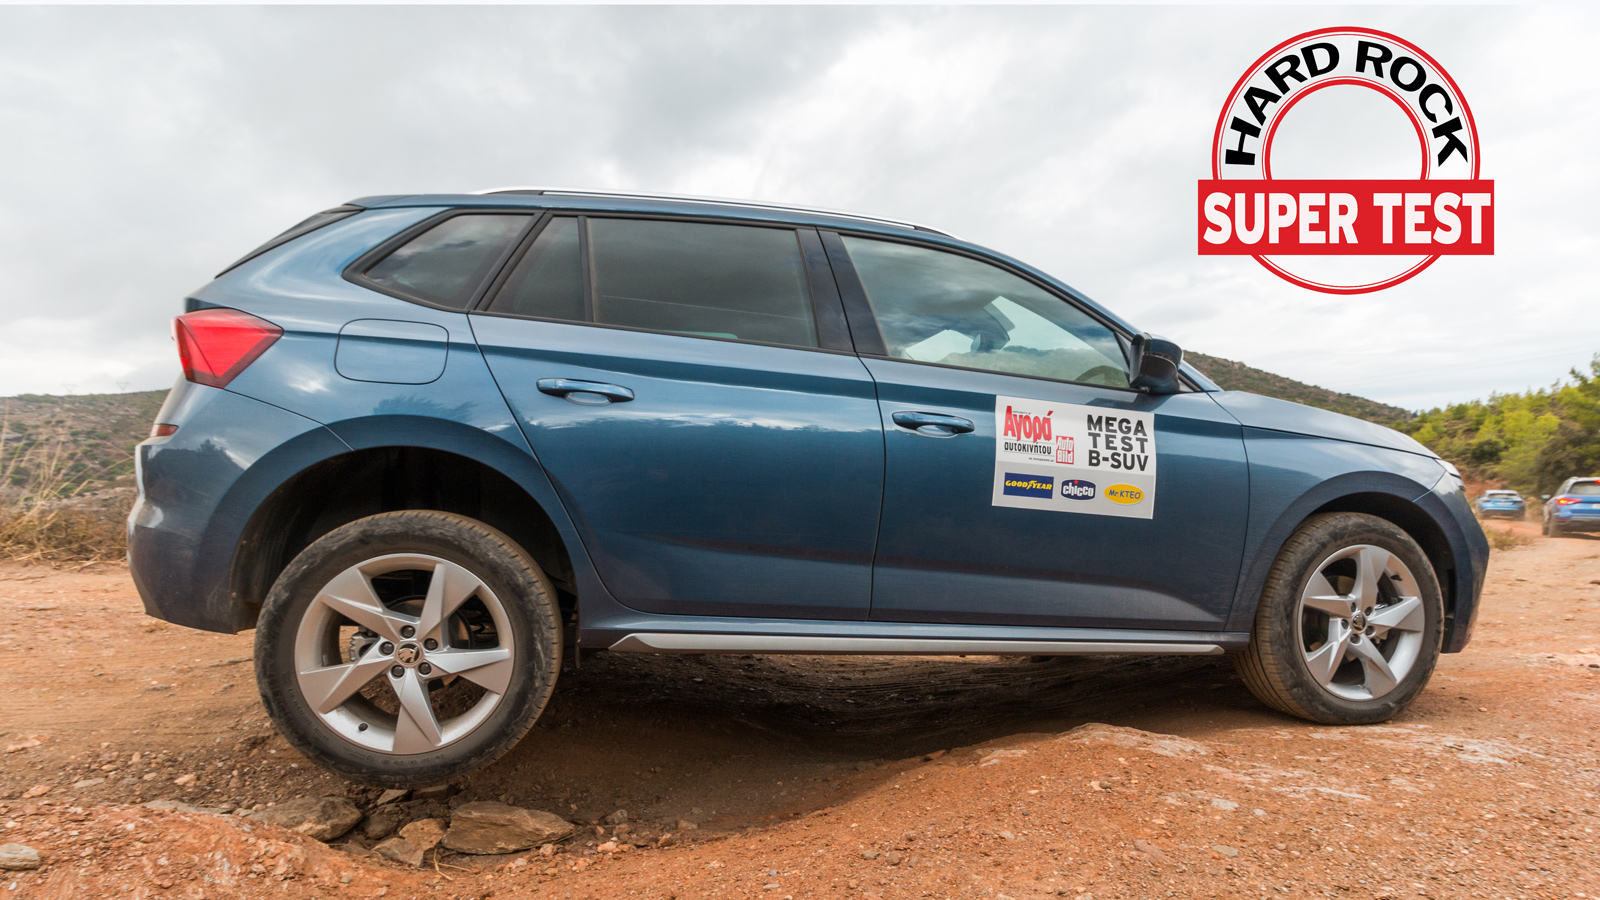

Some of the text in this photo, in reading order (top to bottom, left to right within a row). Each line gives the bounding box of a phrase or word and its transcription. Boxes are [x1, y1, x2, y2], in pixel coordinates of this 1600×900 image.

[1003, 405, 1054, 443] Αγορά
[1087, 414, 1148, 437] MEGA
[1087, 432, 1149, 454] TEST
[1088, 449, 1149, 472] B-SUV
[1005, 480, 1053, 490] GOODYEAR
[1062, 480, 1093, 497] chicco
